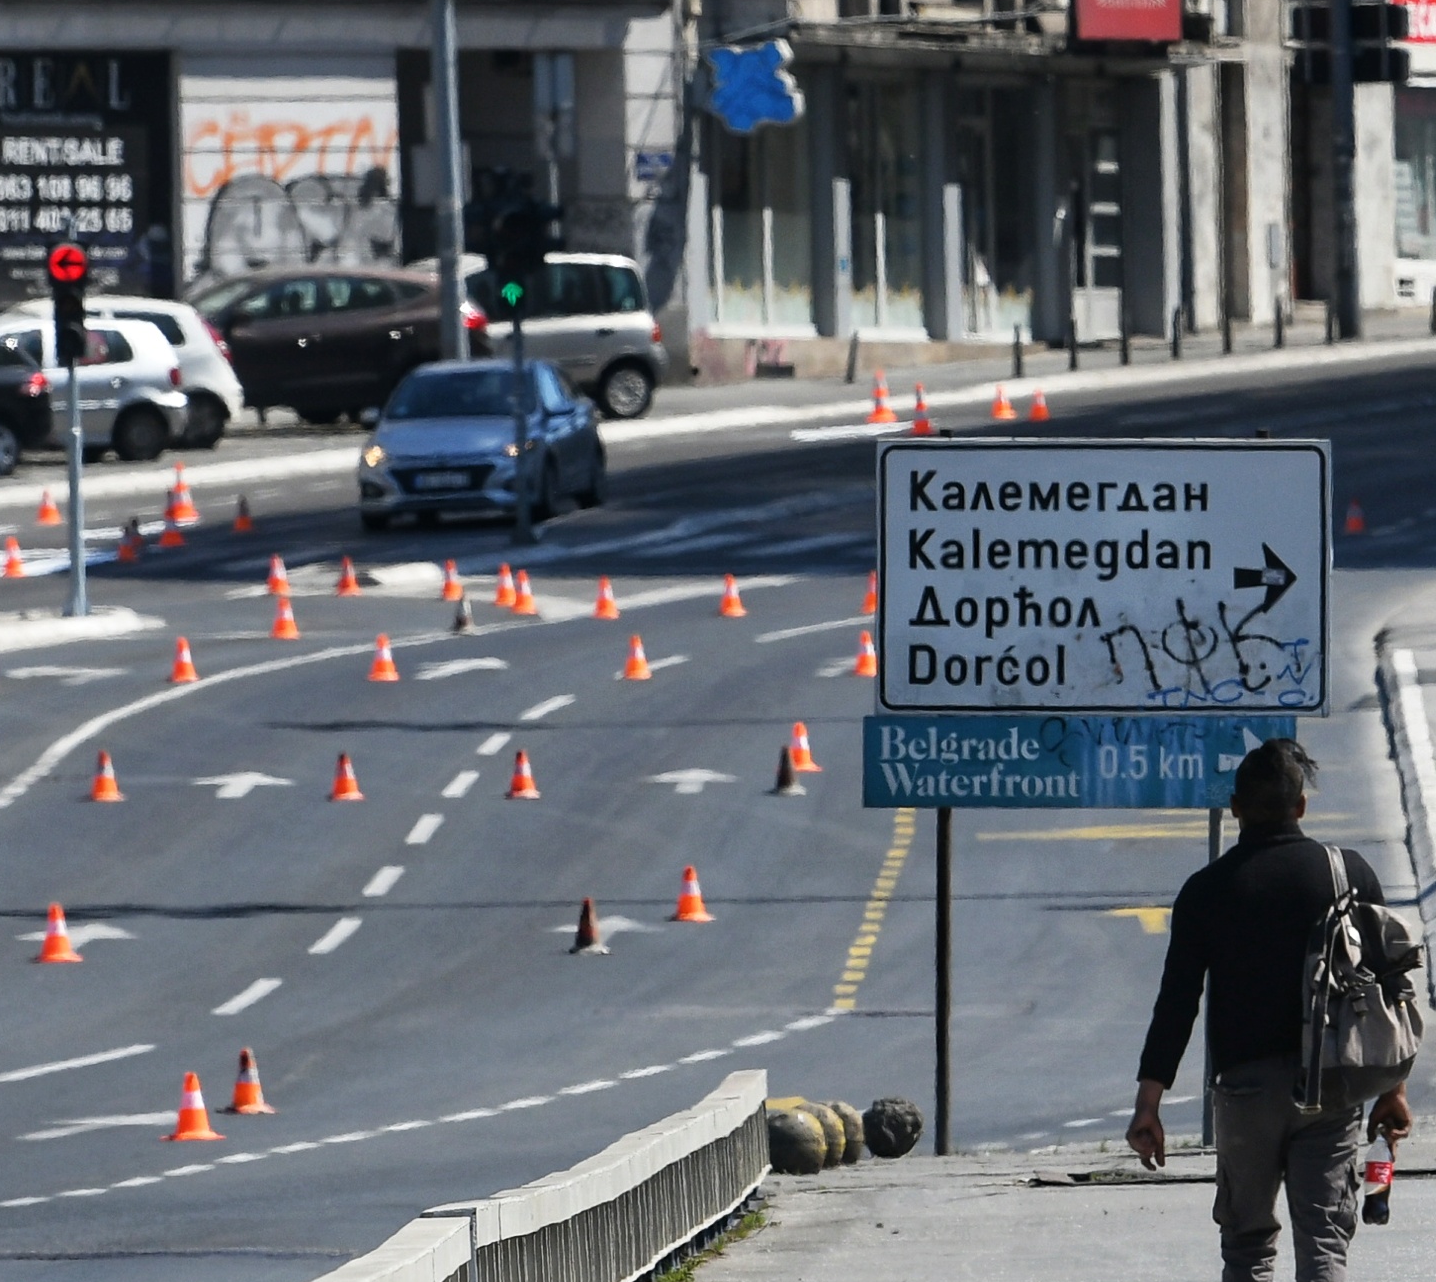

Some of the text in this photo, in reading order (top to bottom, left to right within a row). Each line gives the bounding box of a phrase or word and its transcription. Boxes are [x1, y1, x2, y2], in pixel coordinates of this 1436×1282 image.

[908, 469, 1209, 512] Калемегдан
[908, 528, 1213, 581] Kalemegdan
[908, 585, 1101, 639] Дорћол
[908, 643, 1065, 687] Dorćol
[879, 725, 1041, 765] Belgrade
[1098, 744, 1205, 781] 0.5 km
[880, 761, 1081, 799] Waterfront
